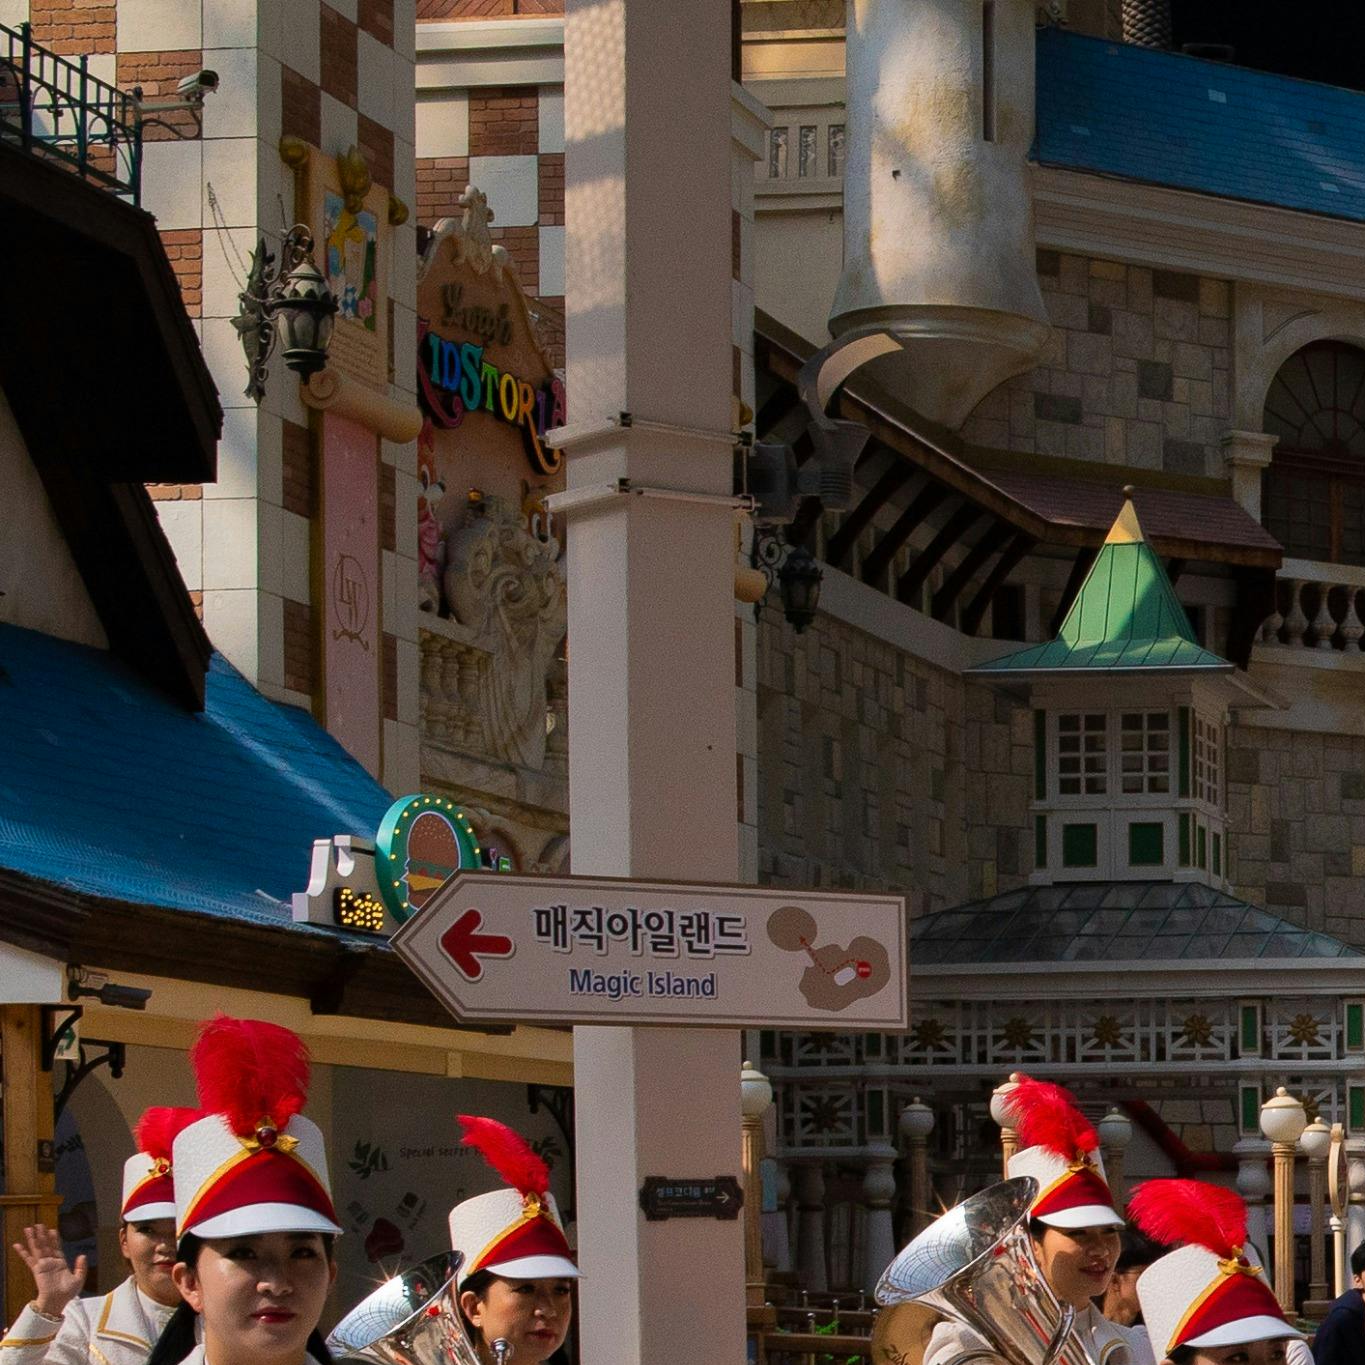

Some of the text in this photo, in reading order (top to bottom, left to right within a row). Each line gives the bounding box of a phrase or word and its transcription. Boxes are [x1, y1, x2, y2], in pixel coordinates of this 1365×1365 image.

[535, 905, 747, 954] 매직아일랜드
[570, 968, 716, 998] Magic Island
